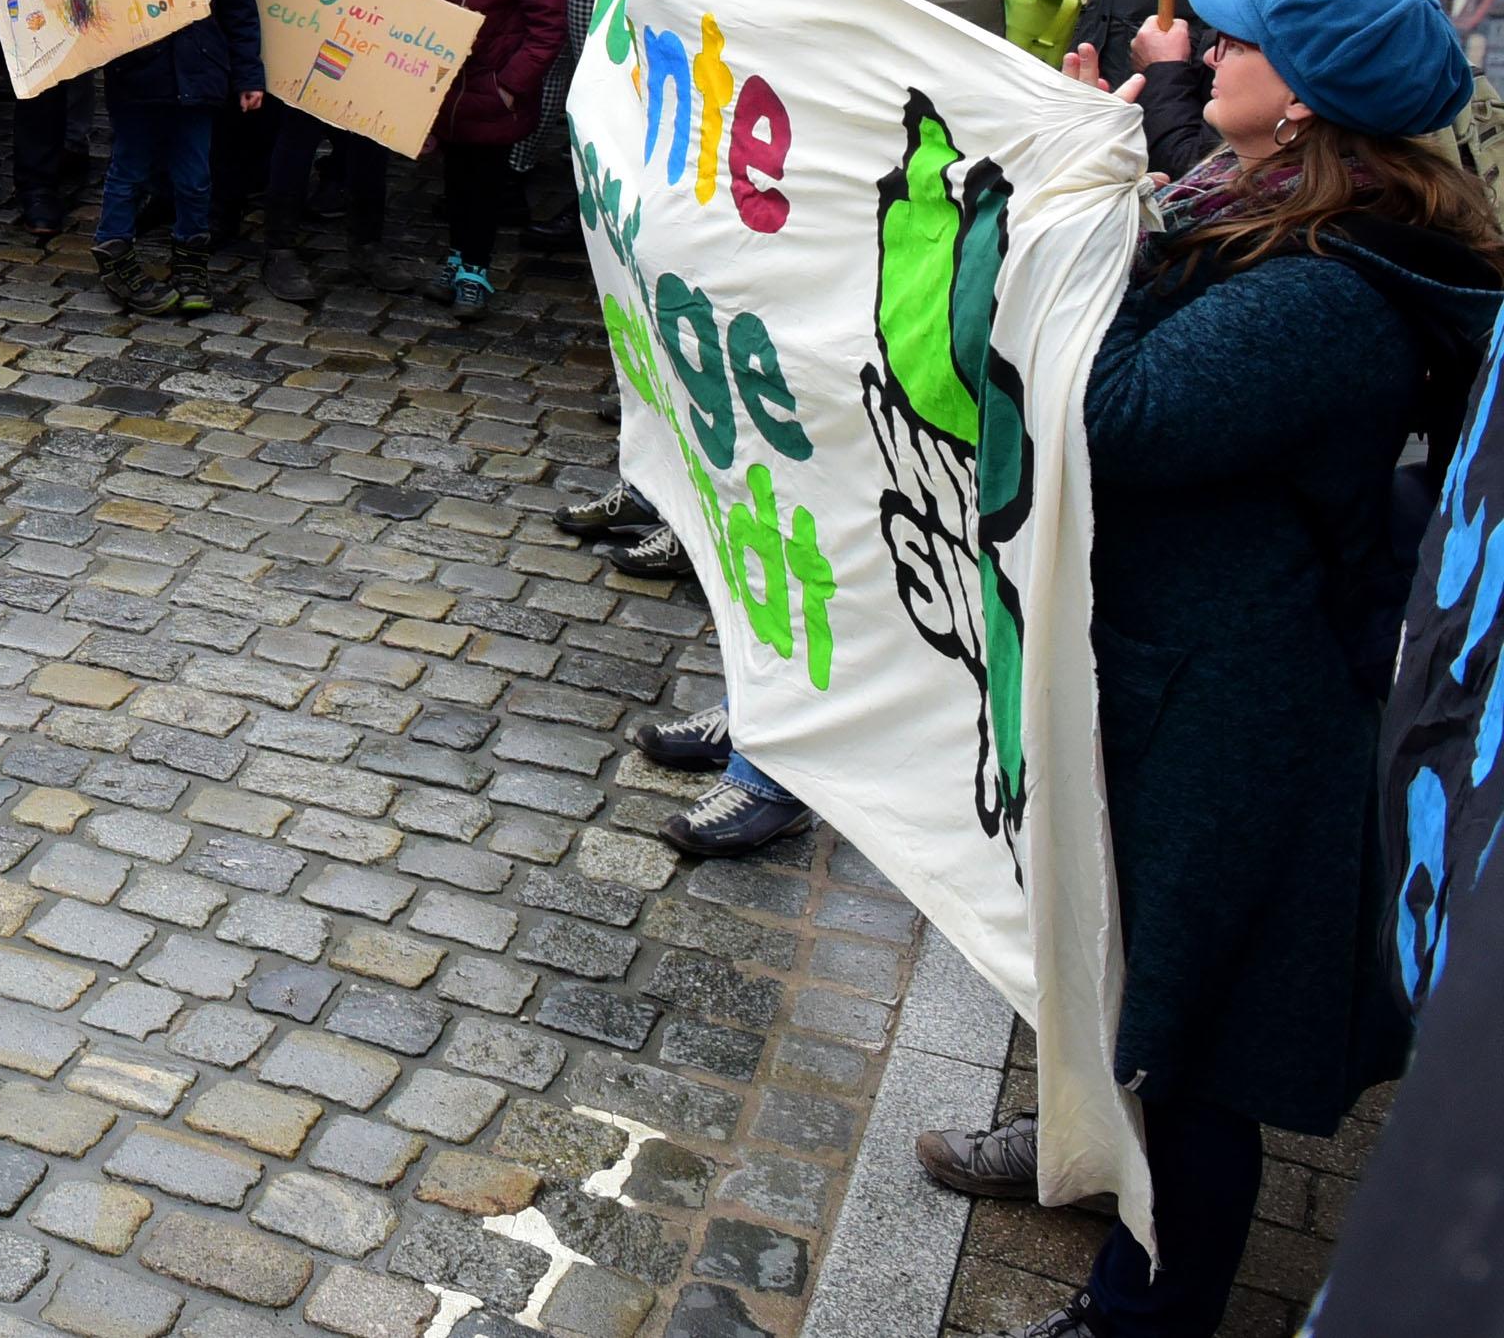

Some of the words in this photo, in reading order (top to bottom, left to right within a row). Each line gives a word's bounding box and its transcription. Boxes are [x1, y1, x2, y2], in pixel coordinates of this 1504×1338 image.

[268, 1, 321, 34] euch
[333, 17, 381, 56] hier
[348, 4, 384, 26] wir
[389, 24, 457, 63] wollen
